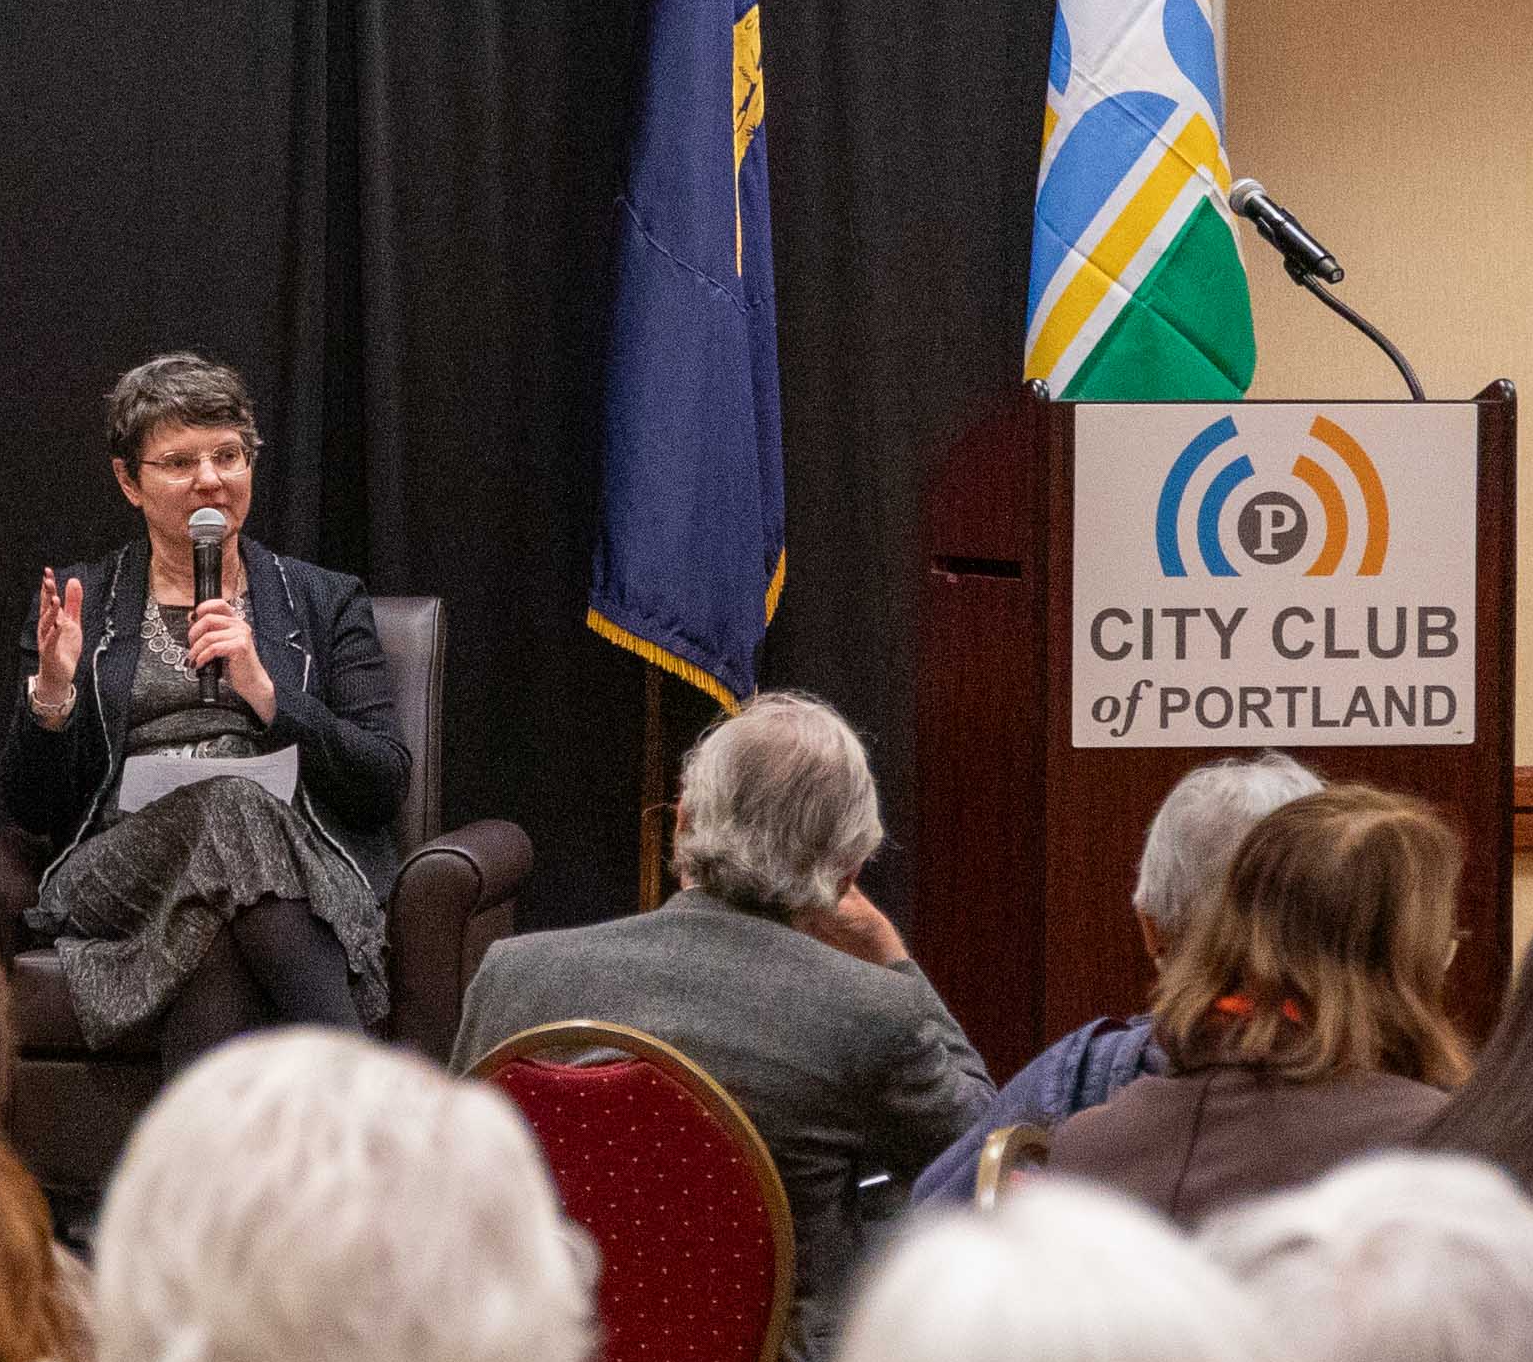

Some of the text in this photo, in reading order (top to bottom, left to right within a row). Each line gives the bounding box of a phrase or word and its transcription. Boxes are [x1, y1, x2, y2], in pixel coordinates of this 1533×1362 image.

[1254, 504, 1297, 555] P
[1089, 605, 1459, 661] CITY CLUB
[1090, 678, 1458, 737] of PORTLAND
